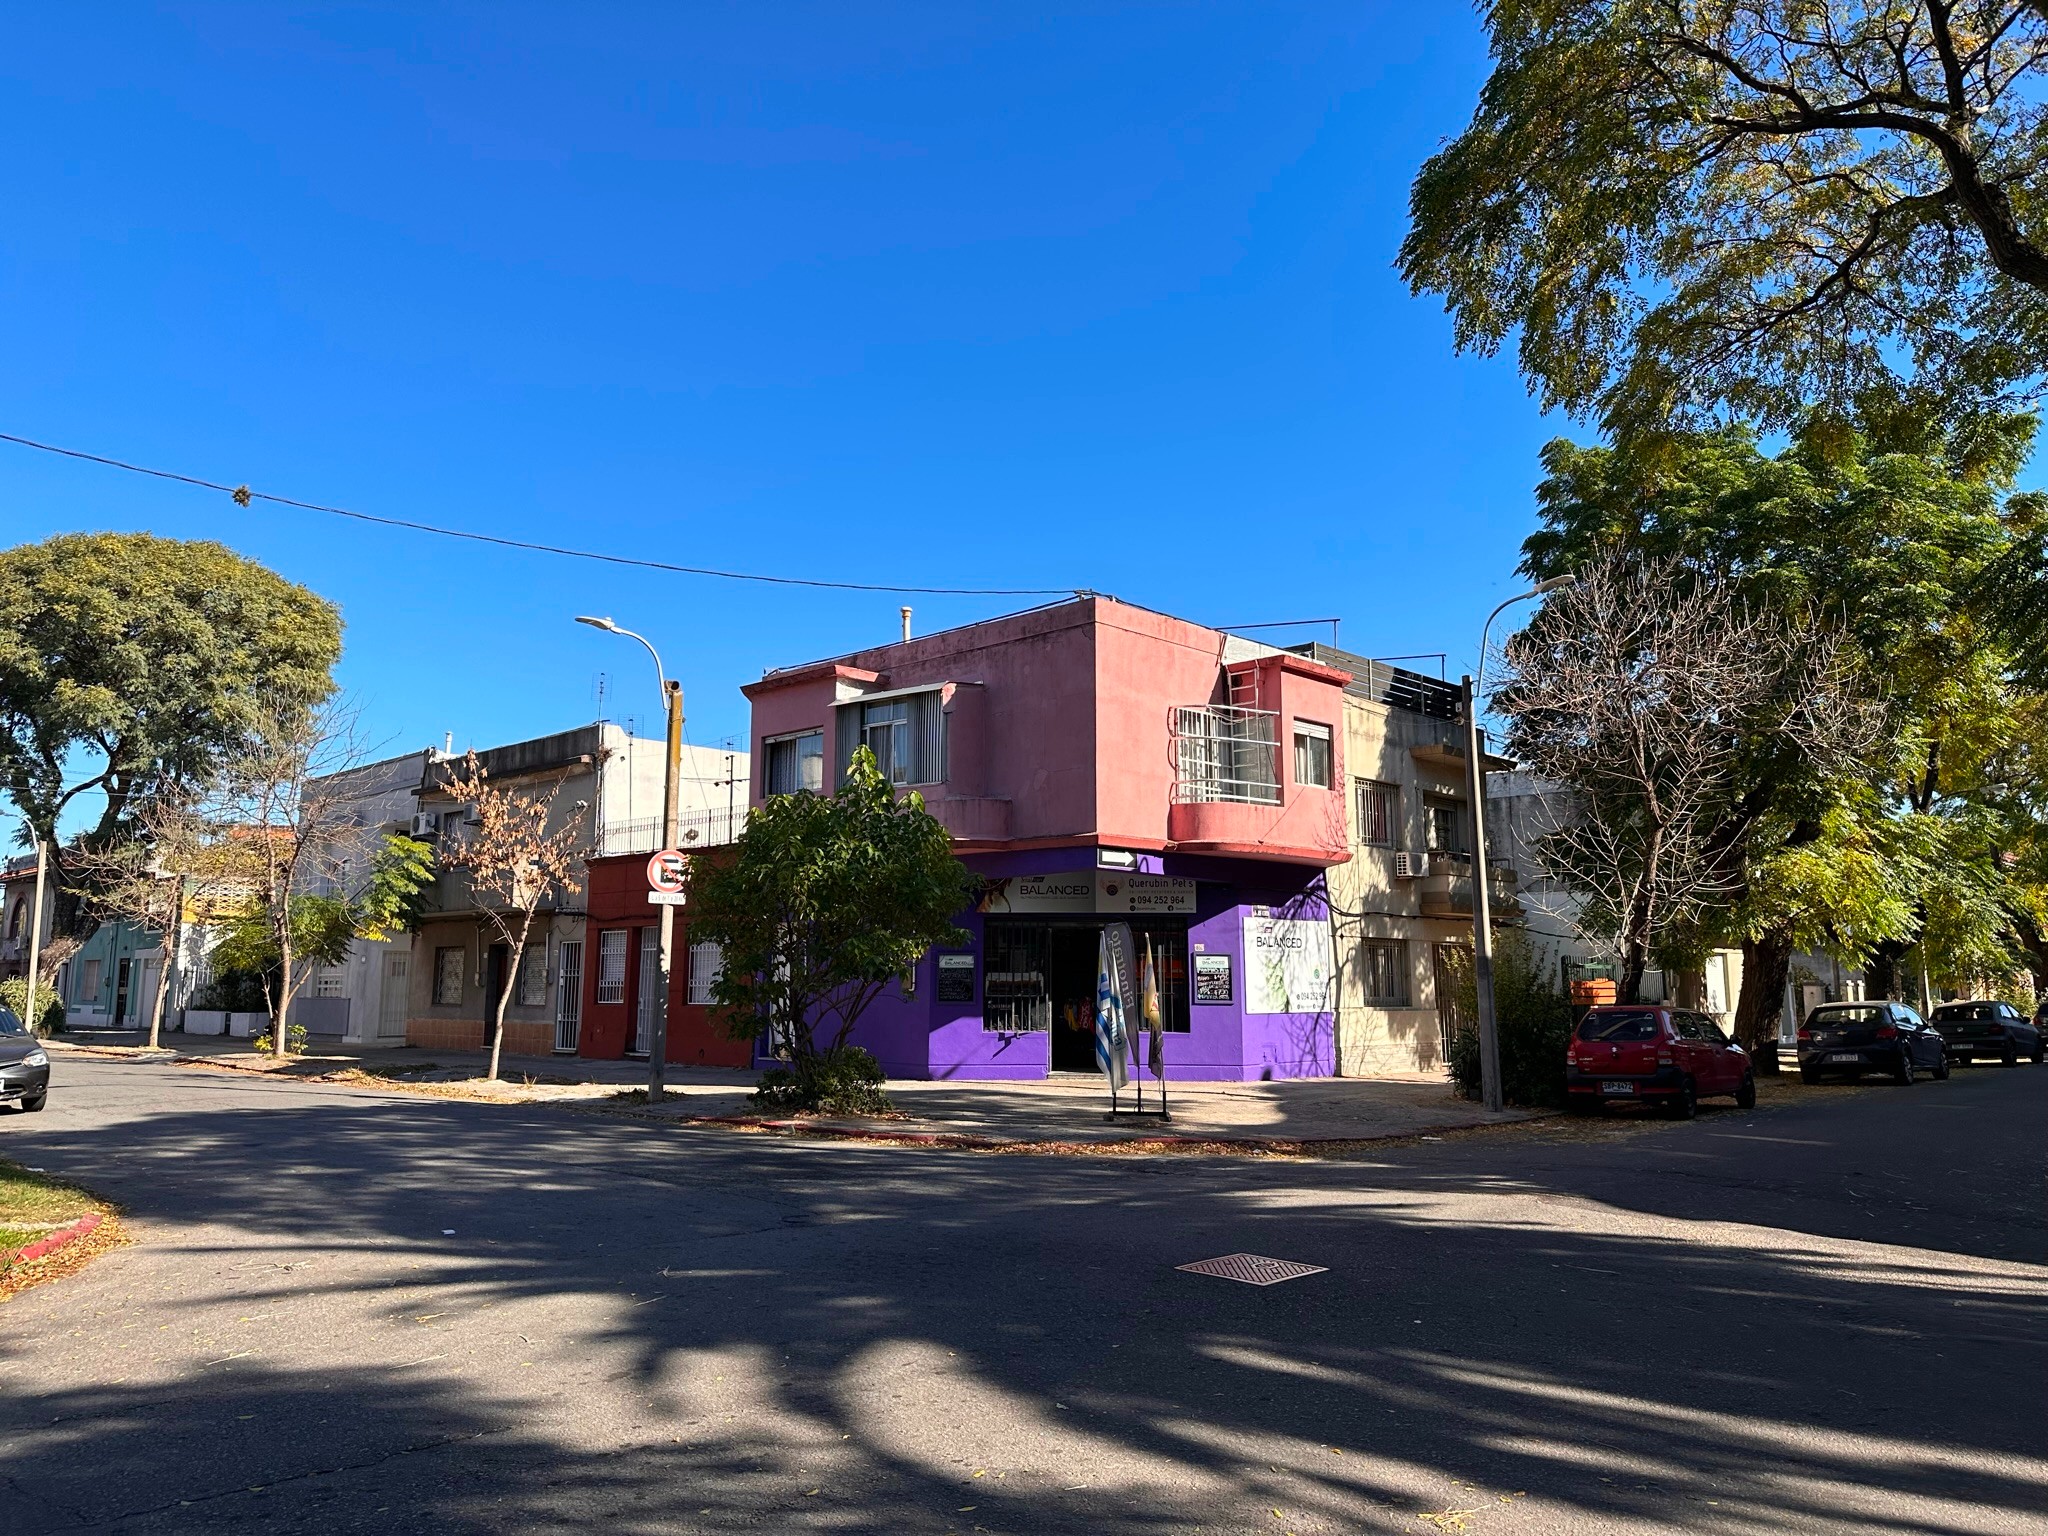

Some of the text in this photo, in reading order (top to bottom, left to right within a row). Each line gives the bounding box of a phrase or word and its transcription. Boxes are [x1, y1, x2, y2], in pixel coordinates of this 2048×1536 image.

[1128, 878, 1168, 888] Querubin
[1020, 885, 1089, 895] BALANCED
[1137, 896, 1185, 904] 094 252 964
[1256, 936, 1303, 949] BALANCED
